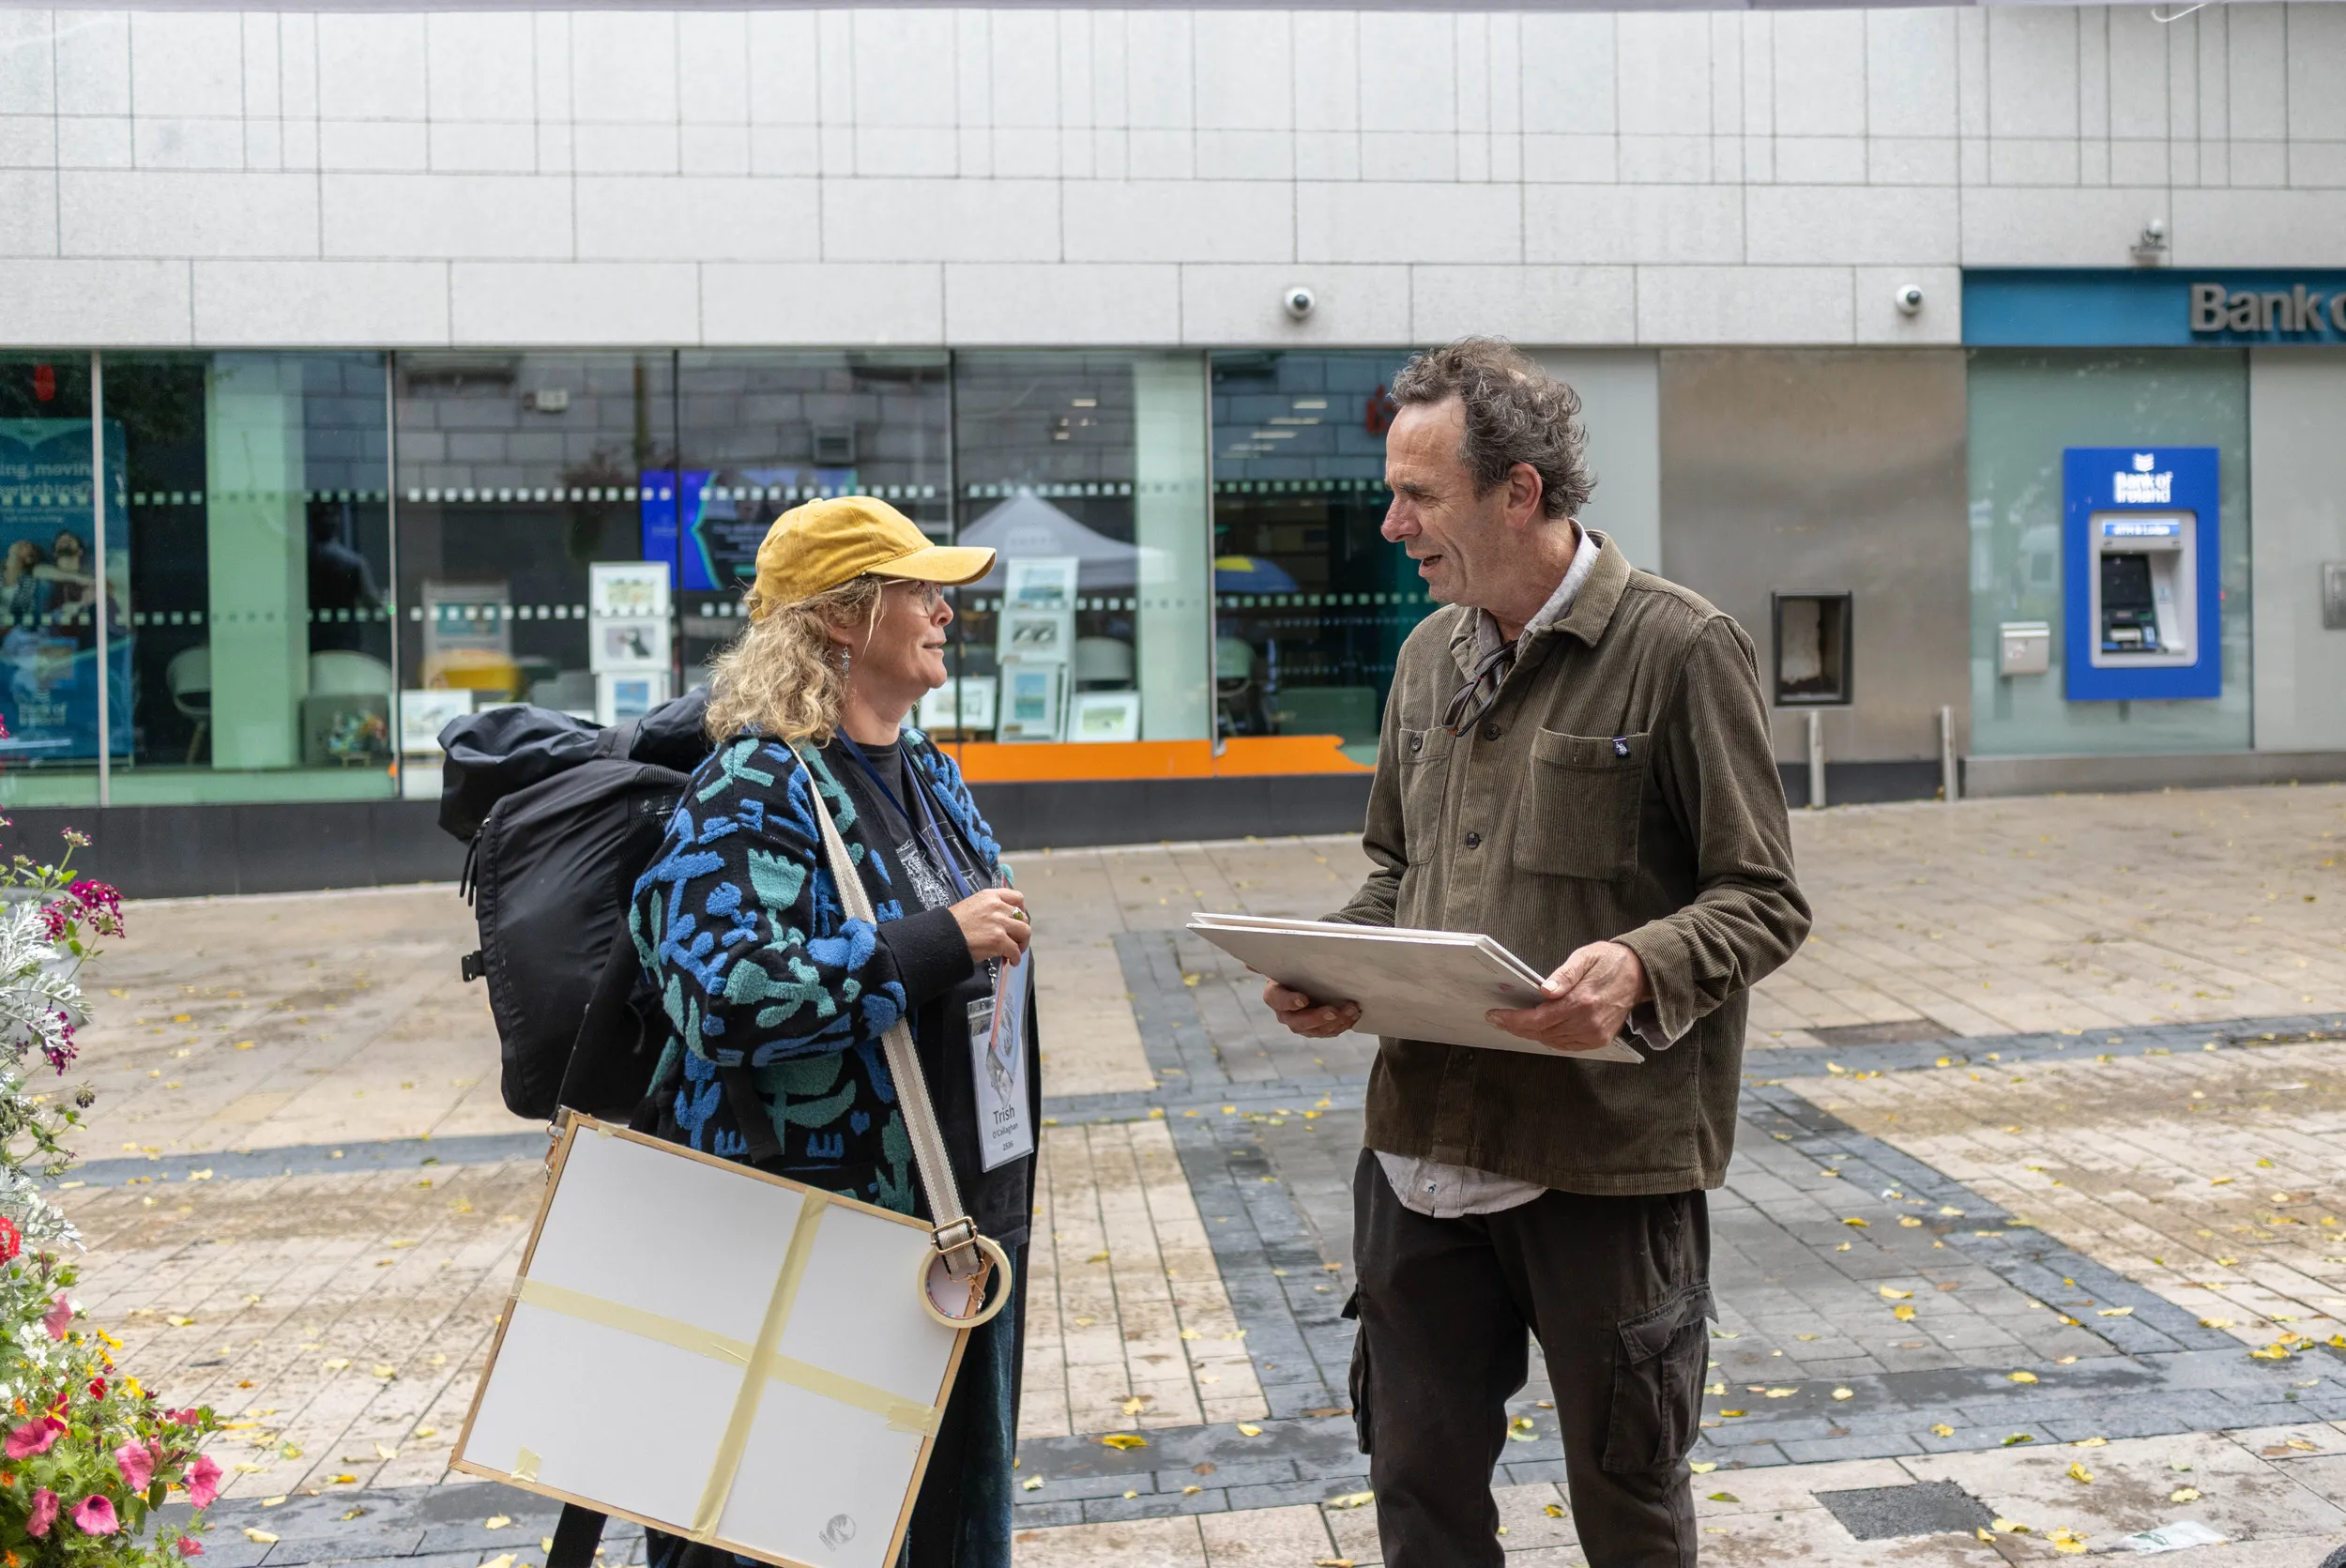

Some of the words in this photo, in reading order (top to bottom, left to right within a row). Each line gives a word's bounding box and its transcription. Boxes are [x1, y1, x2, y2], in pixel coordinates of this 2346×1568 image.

[2190, 283, 2327, 332] Bank
[34, 462, 93, 477] movin
[993, 1104, 1015, 1124] Trish
